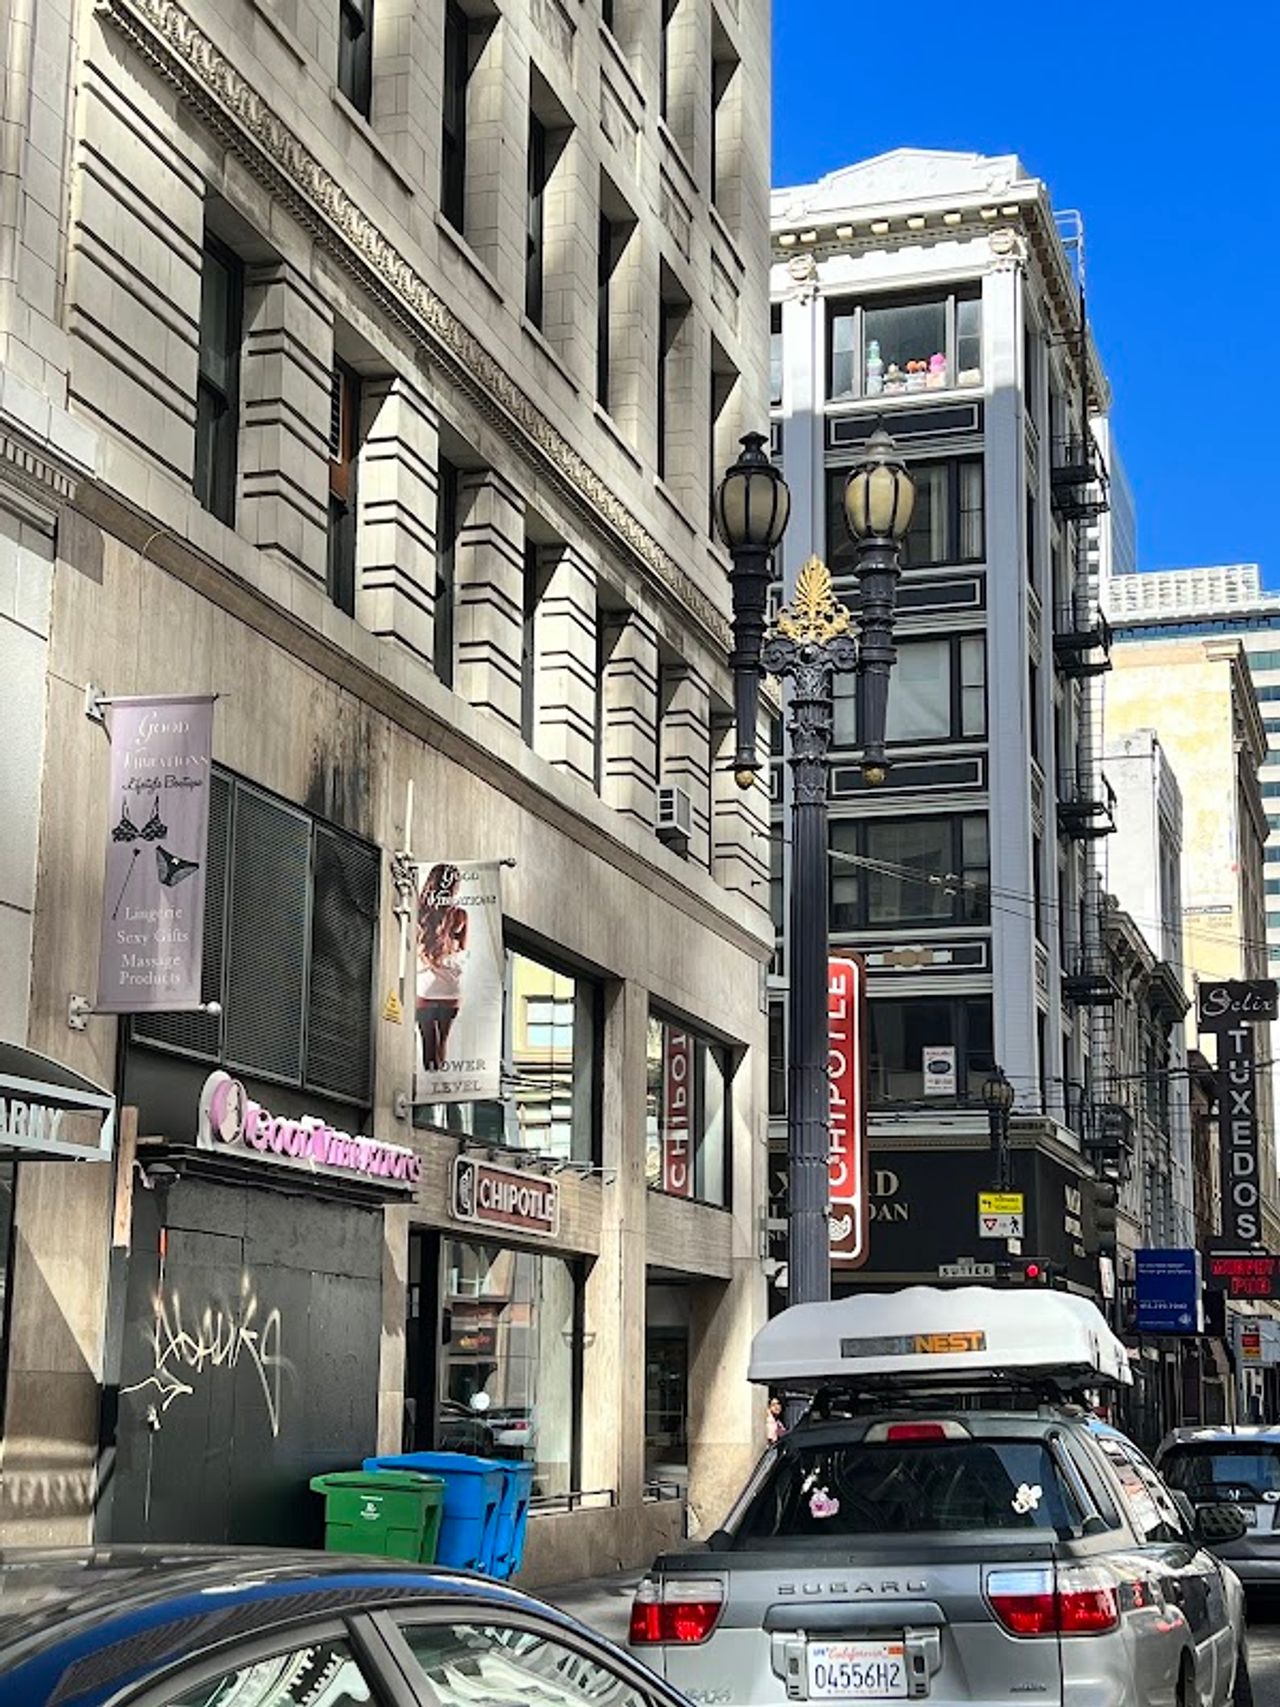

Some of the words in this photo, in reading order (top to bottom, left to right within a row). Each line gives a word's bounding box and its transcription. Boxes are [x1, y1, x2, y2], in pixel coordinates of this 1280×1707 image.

[116, 930, 148, 947] Sexy
[153, 928, 190, 943] Gifts
[431, 1079, 482, 1095] LEVEL
[1227, 1029, 1259, 1239] TUXEDOS
[480, 1177, 555, 1223] CHIPOTLE
[913, 1331, 983, 1354] NEST
[778, 1580, 927, 1596] SUBARU
[828, 1644, 887, 1662] California
[815, 1661, 901, 1689] 04556H2
